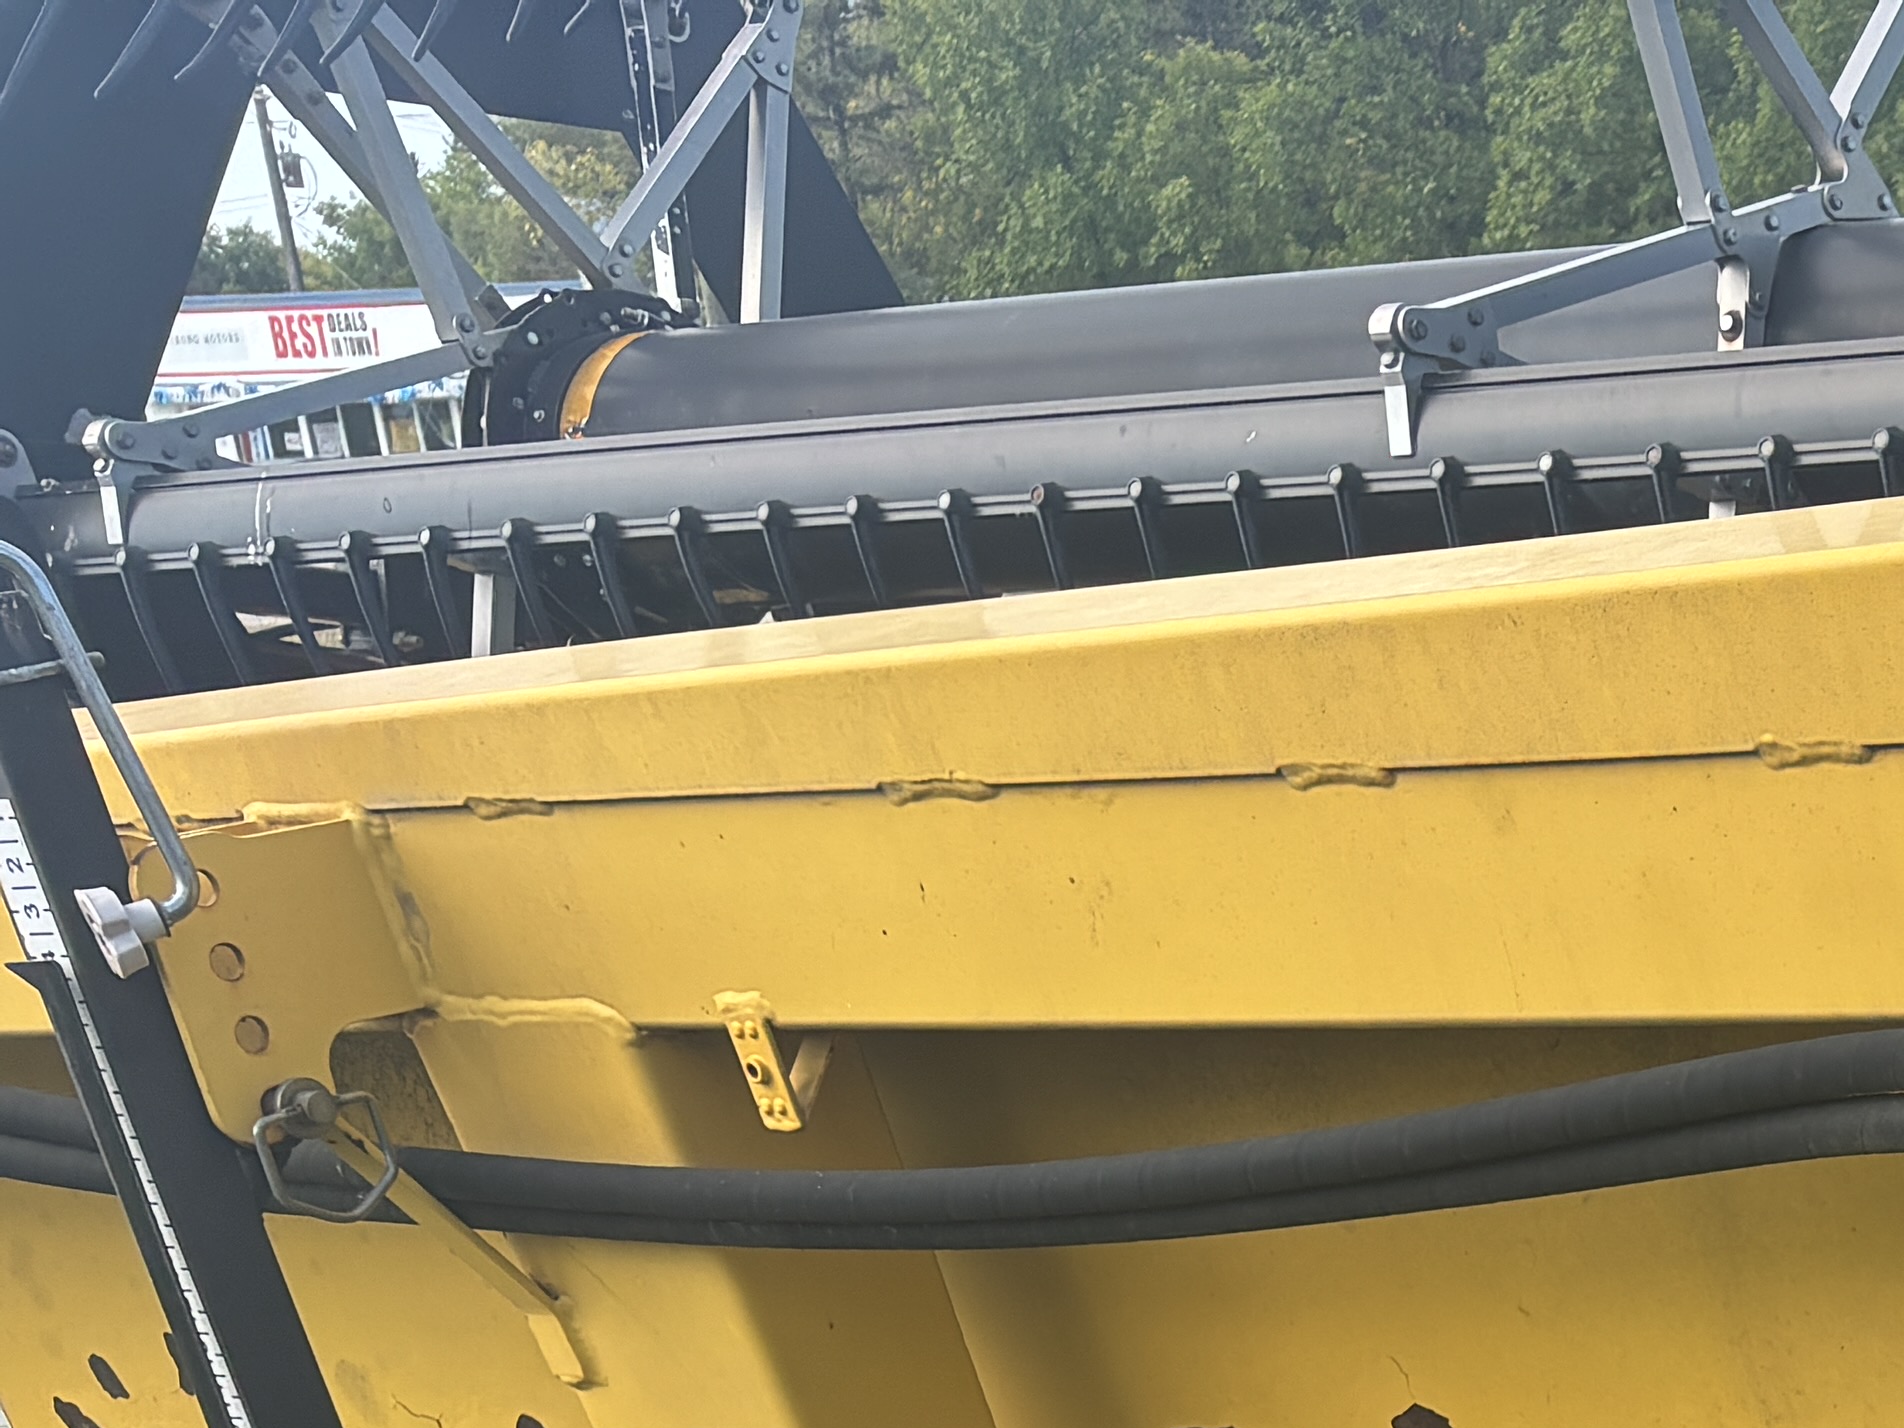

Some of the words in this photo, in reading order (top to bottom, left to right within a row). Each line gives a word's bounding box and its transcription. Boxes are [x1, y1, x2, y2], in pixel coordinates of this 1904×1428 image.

[328, 311, 367, 333] DEALS
[268, 313, 328, 359] BEST
[333, 338, 344, 357] IN
[5, 857, 25, 874] 2
[23, 903, 40, 919] 3
